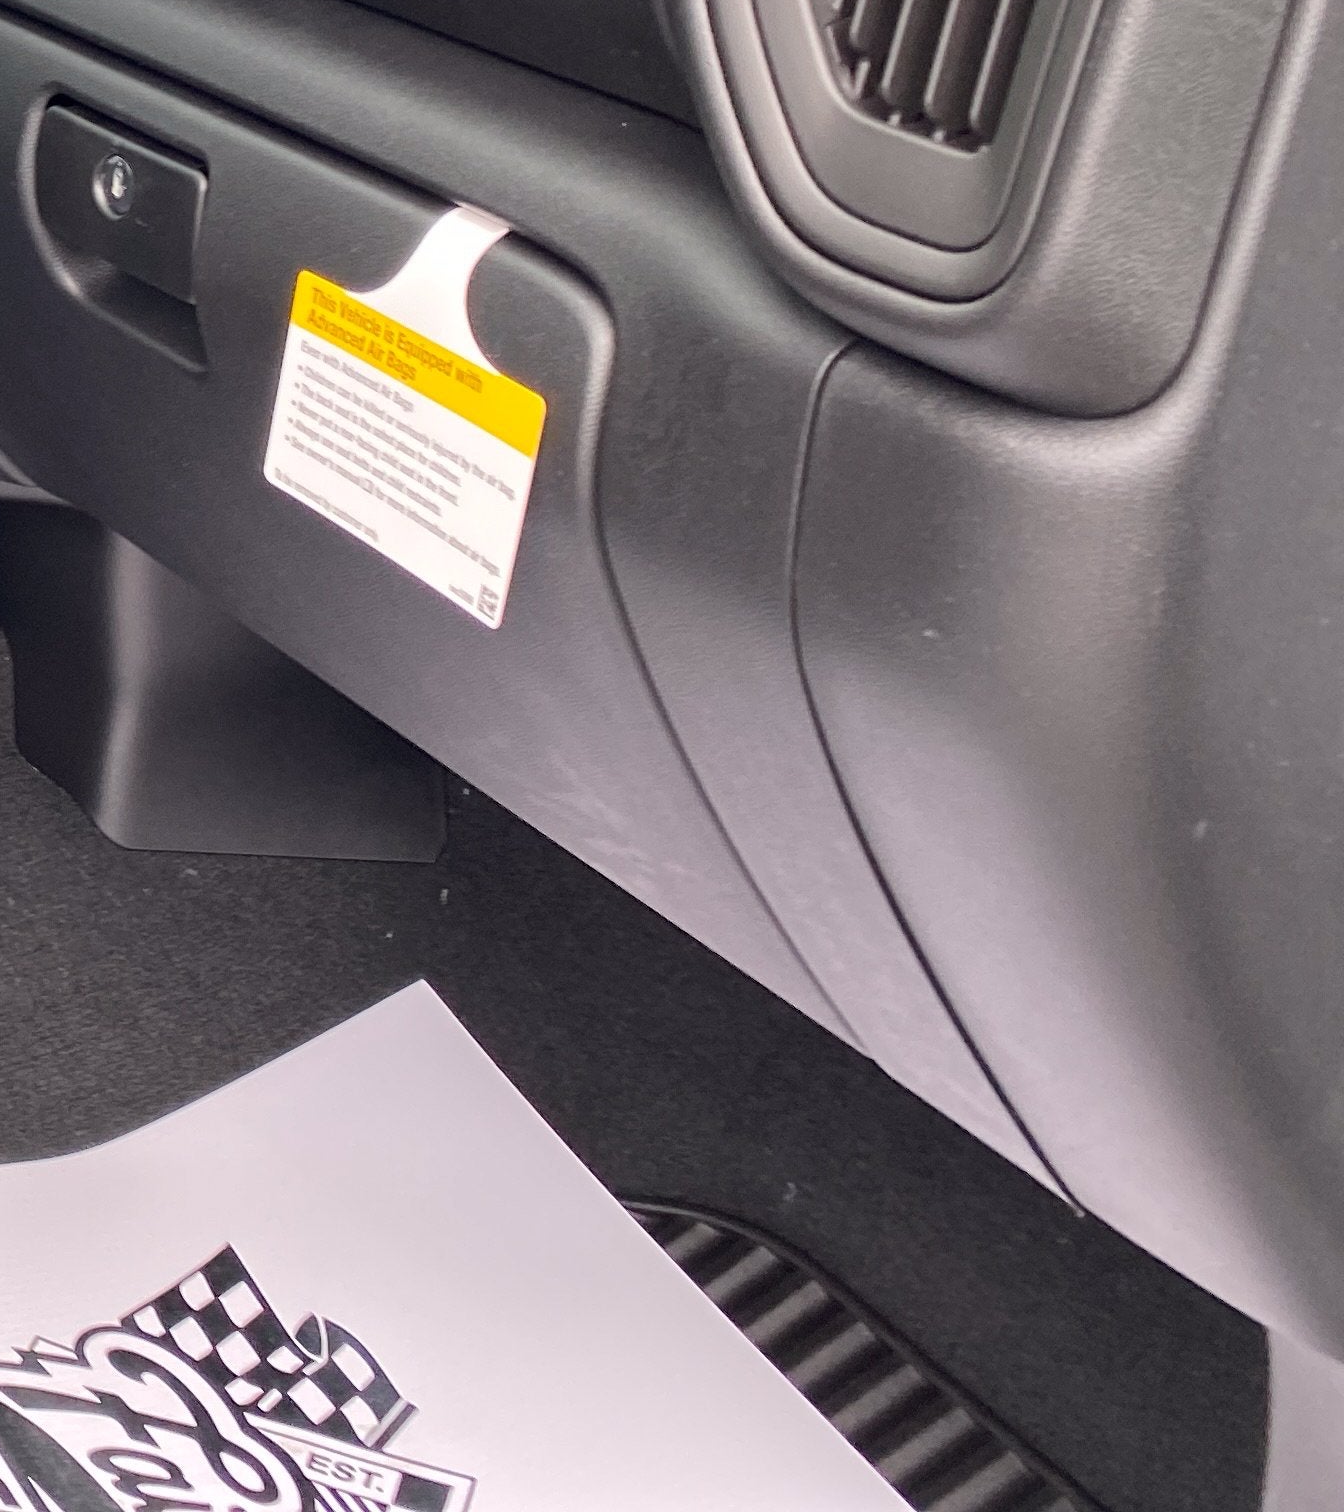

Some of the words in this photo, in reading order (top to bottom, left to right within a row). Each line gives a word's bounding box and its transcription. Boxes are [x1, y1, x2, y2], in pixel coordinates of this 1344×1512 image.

[307, 307, 364, 351] Advanced
[367, 340, 384, 362] Air
[385, 351, 416, 383] Bags
[311, 287, 336, 314] This
[338, 302, 381, 338] Vehicle
[384, 326, 394, 345] is
[397, 333, 452, 380] Equipped
[307, 1453, 385, 1494] EST.
